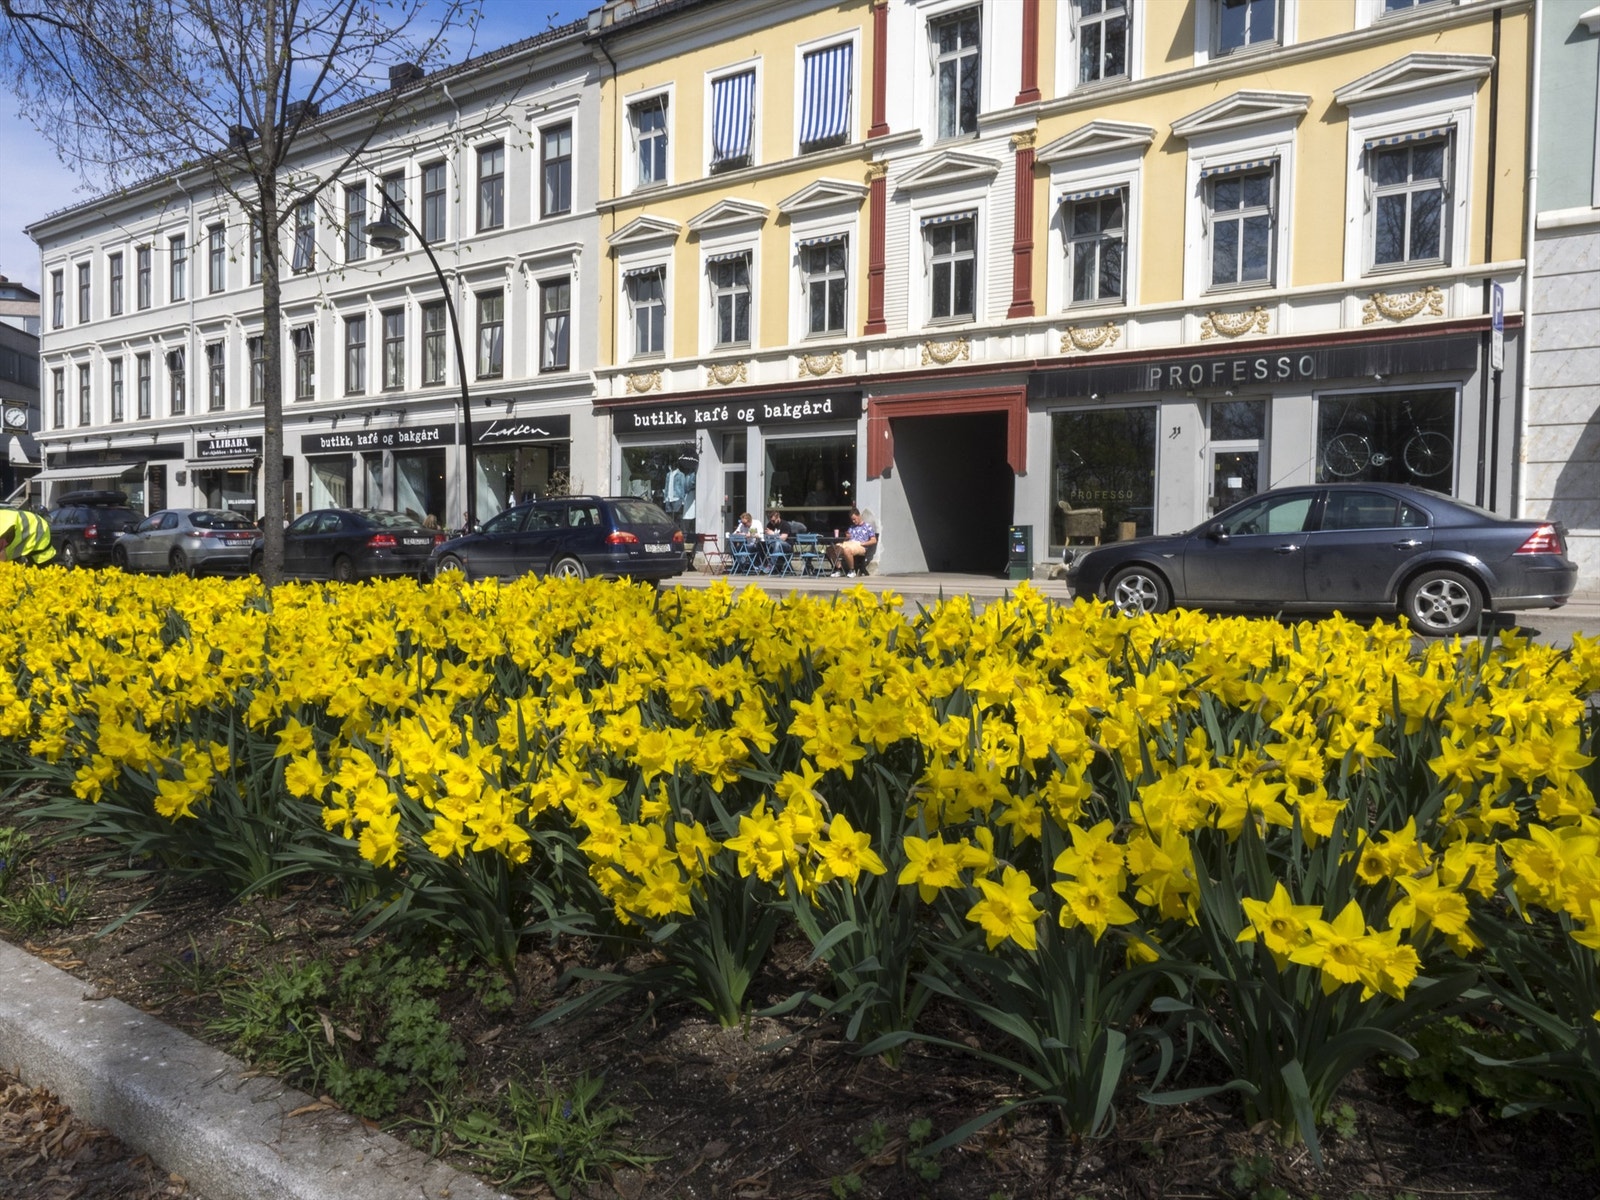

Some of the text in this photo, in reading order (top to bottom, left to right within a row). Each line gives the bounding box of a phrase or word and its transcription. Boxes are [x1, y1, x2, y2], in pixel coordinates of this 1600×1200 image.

[1494, 290, 1502, 325] P
[1150, 355, 1315, 387] PROFESSO
[634, 399, 832, 427] butikk, kafé og bakgård
[320, 428, 439, 448] butikk, kafé og bakgård
[479, 420, 550, 441] Larsen
[209, 438, 248, 449] ALIBABA
[1070, 490, 1133, 500] PROFESSO
